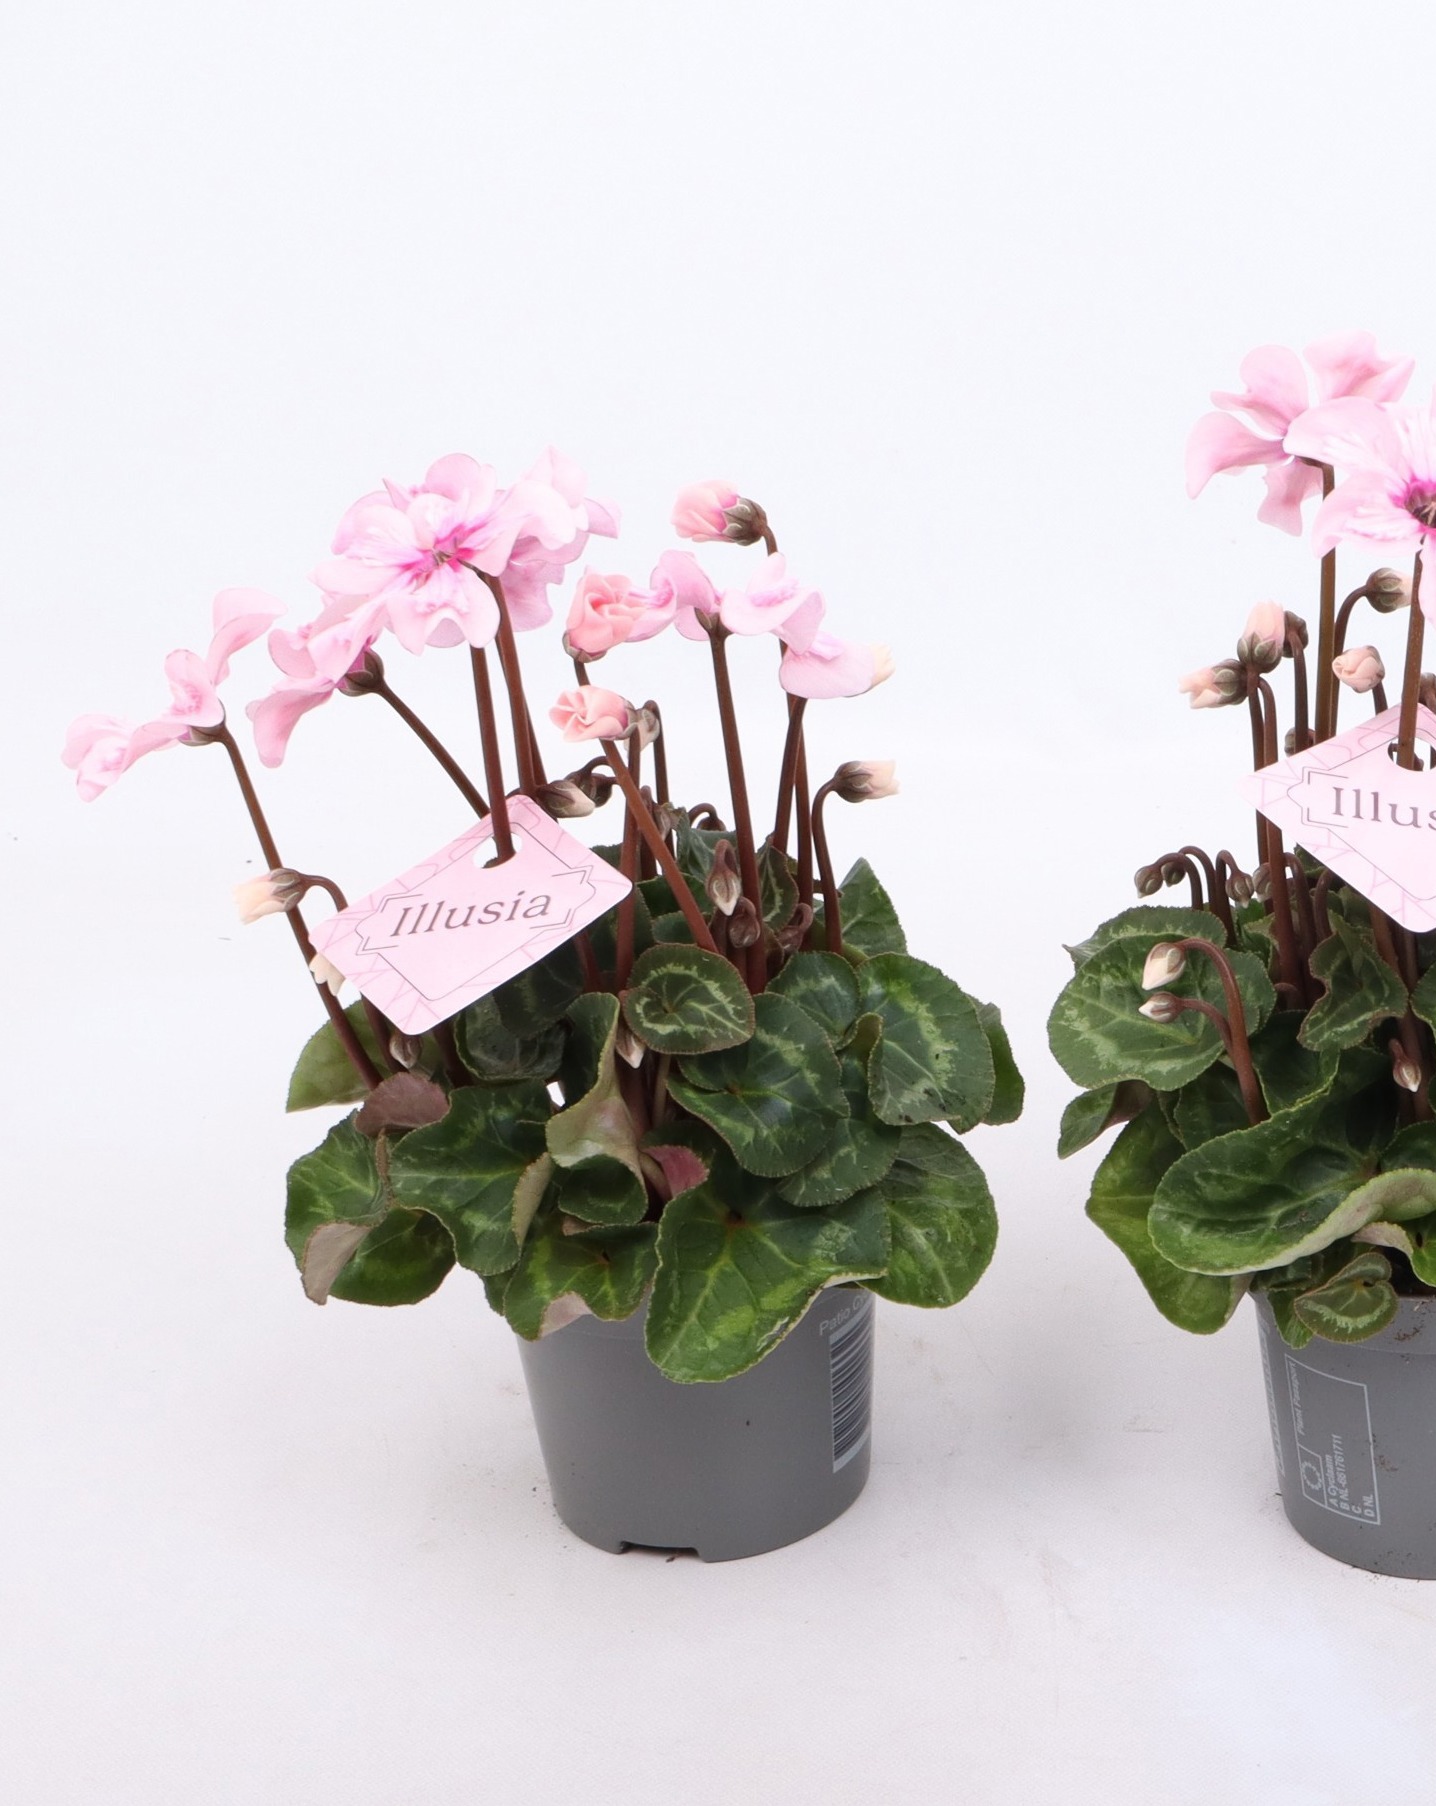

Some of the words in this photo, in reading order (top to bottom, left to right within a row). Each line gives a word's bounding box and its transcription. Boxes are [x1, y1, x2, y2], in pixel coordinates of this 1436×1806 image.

[389, 889, 552, 938] Illusia
[819, 1308, 850, 1336] Patio
[1328, 1498, 1339, 1509] A
[1339, 1501, 1350, 1511] B
[1362, 1493, 1375, 1508] NL
[1363, 1508, 1375, 1518] D
